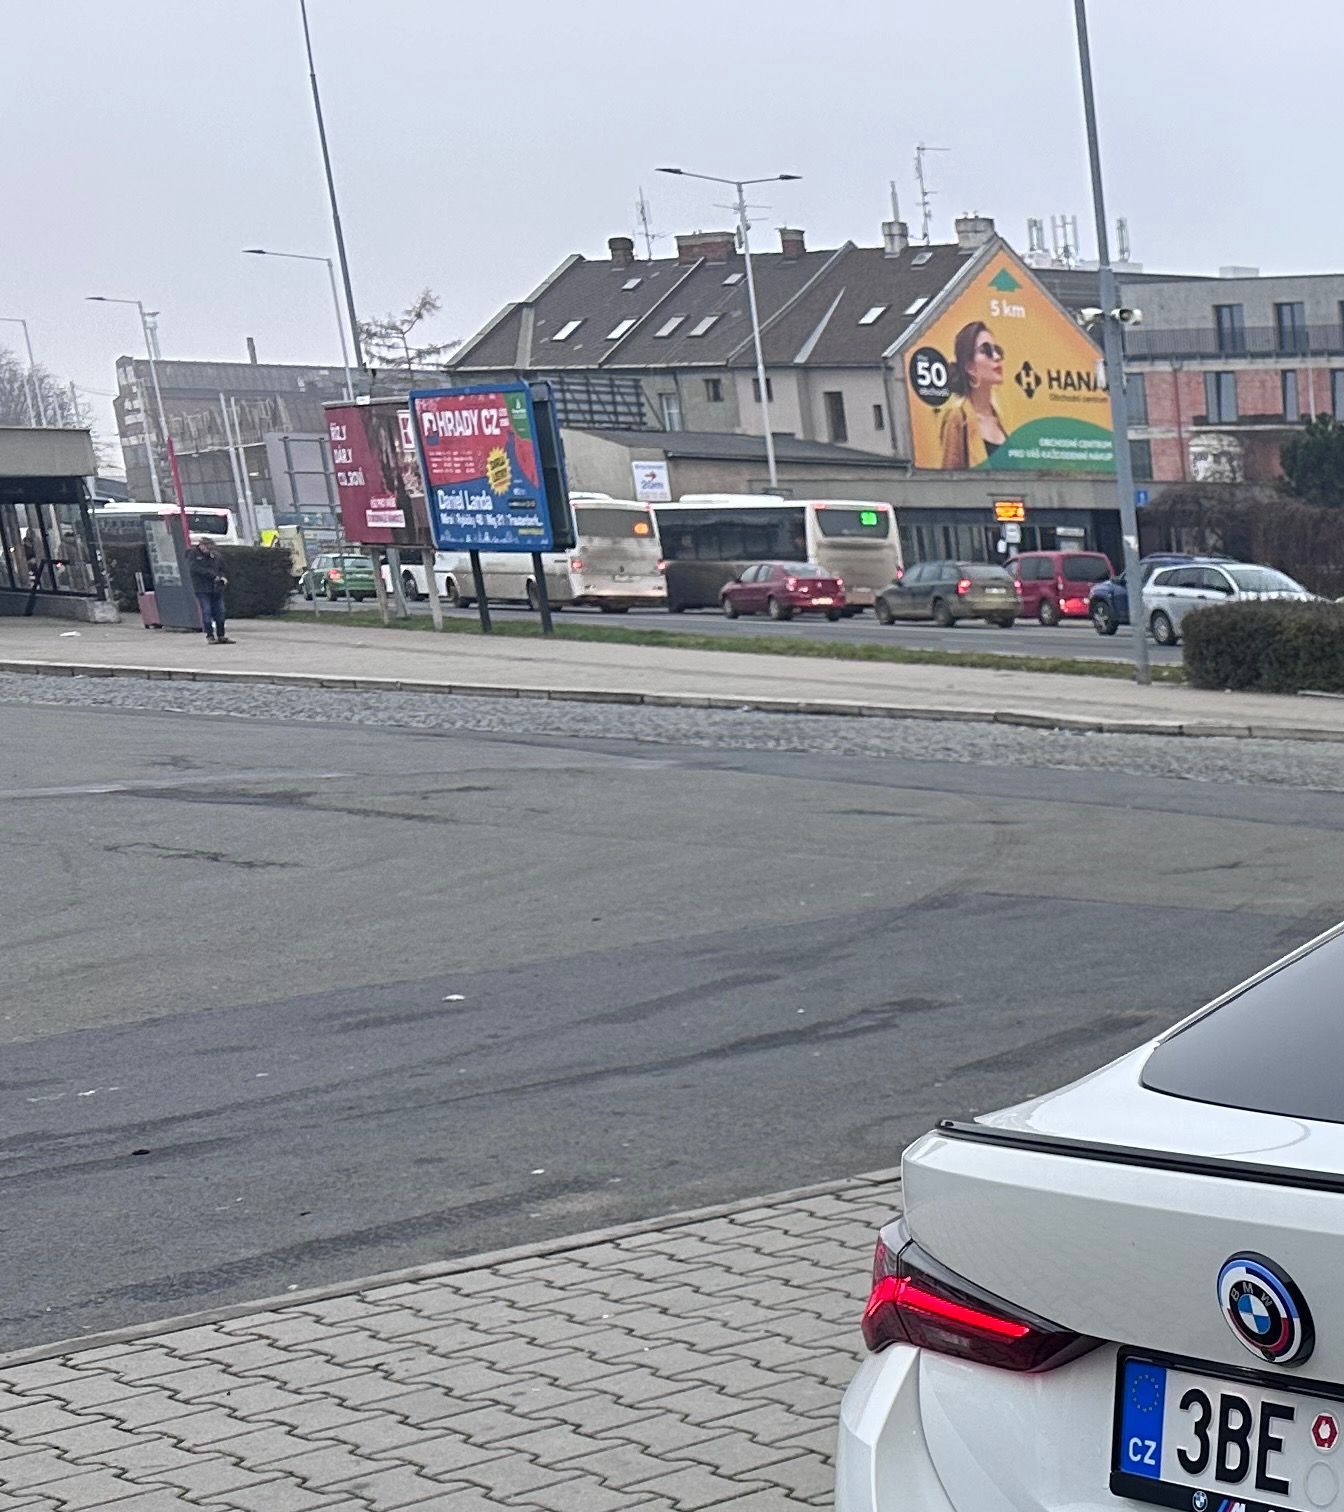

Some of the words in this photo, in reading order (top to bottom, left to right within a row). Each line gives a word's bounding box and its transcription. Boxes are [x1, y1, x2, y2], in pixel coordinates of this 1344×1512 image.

[991, 299, 1001, 317] 5
[1002, 299, 1025, 318] km
[917, 361, 948, 388] 50
[436, 408, 479, 437] HRADY
[481, 408, 501, 436] CZ
[437, 489, 465, 511] Daniel
[464, 489, 494, 511] Landa
[1229, 1281, 1274, 1308] BMW
[1128, 1436, 1157, 1466] CZ
[1176, 1388, 1296, 1496] 3BE
